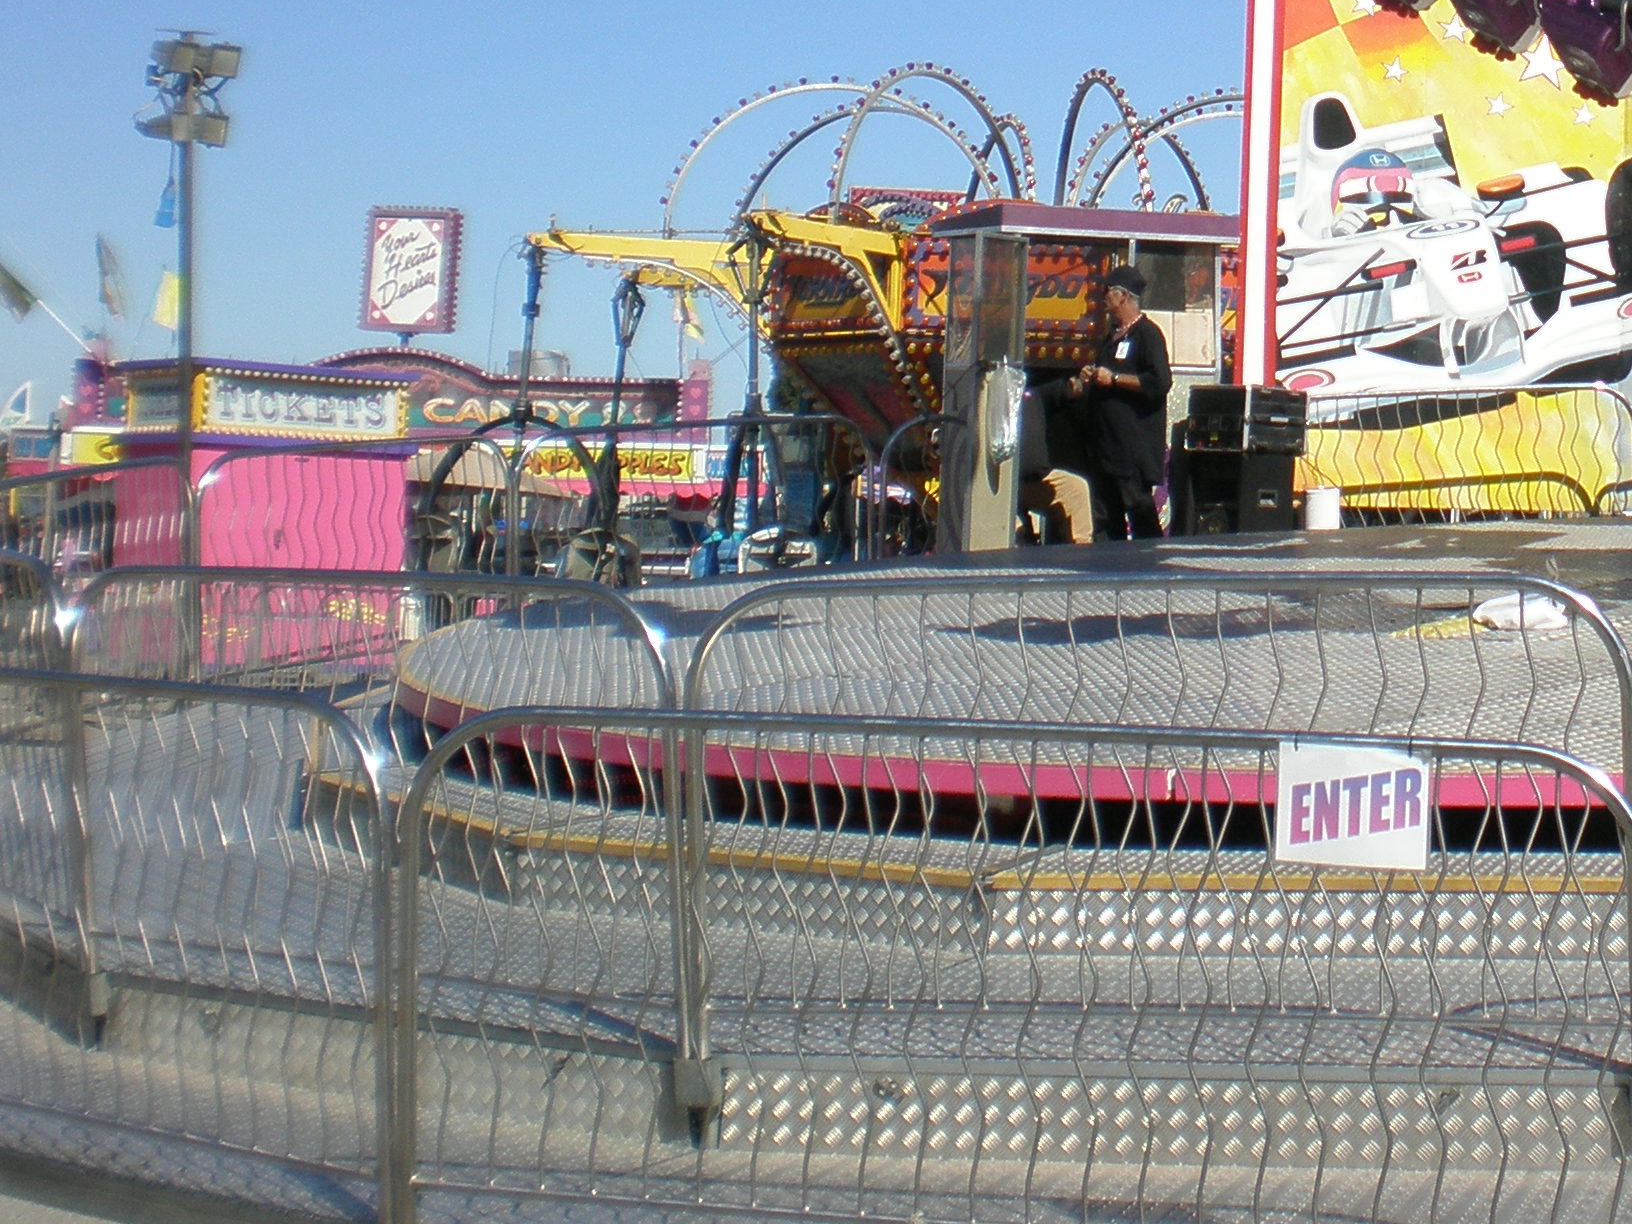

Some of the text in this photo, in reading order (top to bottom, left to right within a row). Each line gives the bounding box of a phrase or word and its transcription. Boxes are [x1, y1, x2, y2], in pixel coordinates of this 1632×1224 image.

[380, 231, 421, 255] Your
[218, 384, 386, 430] TICKETS
[1289, 767, 1423, 846] ENTER
